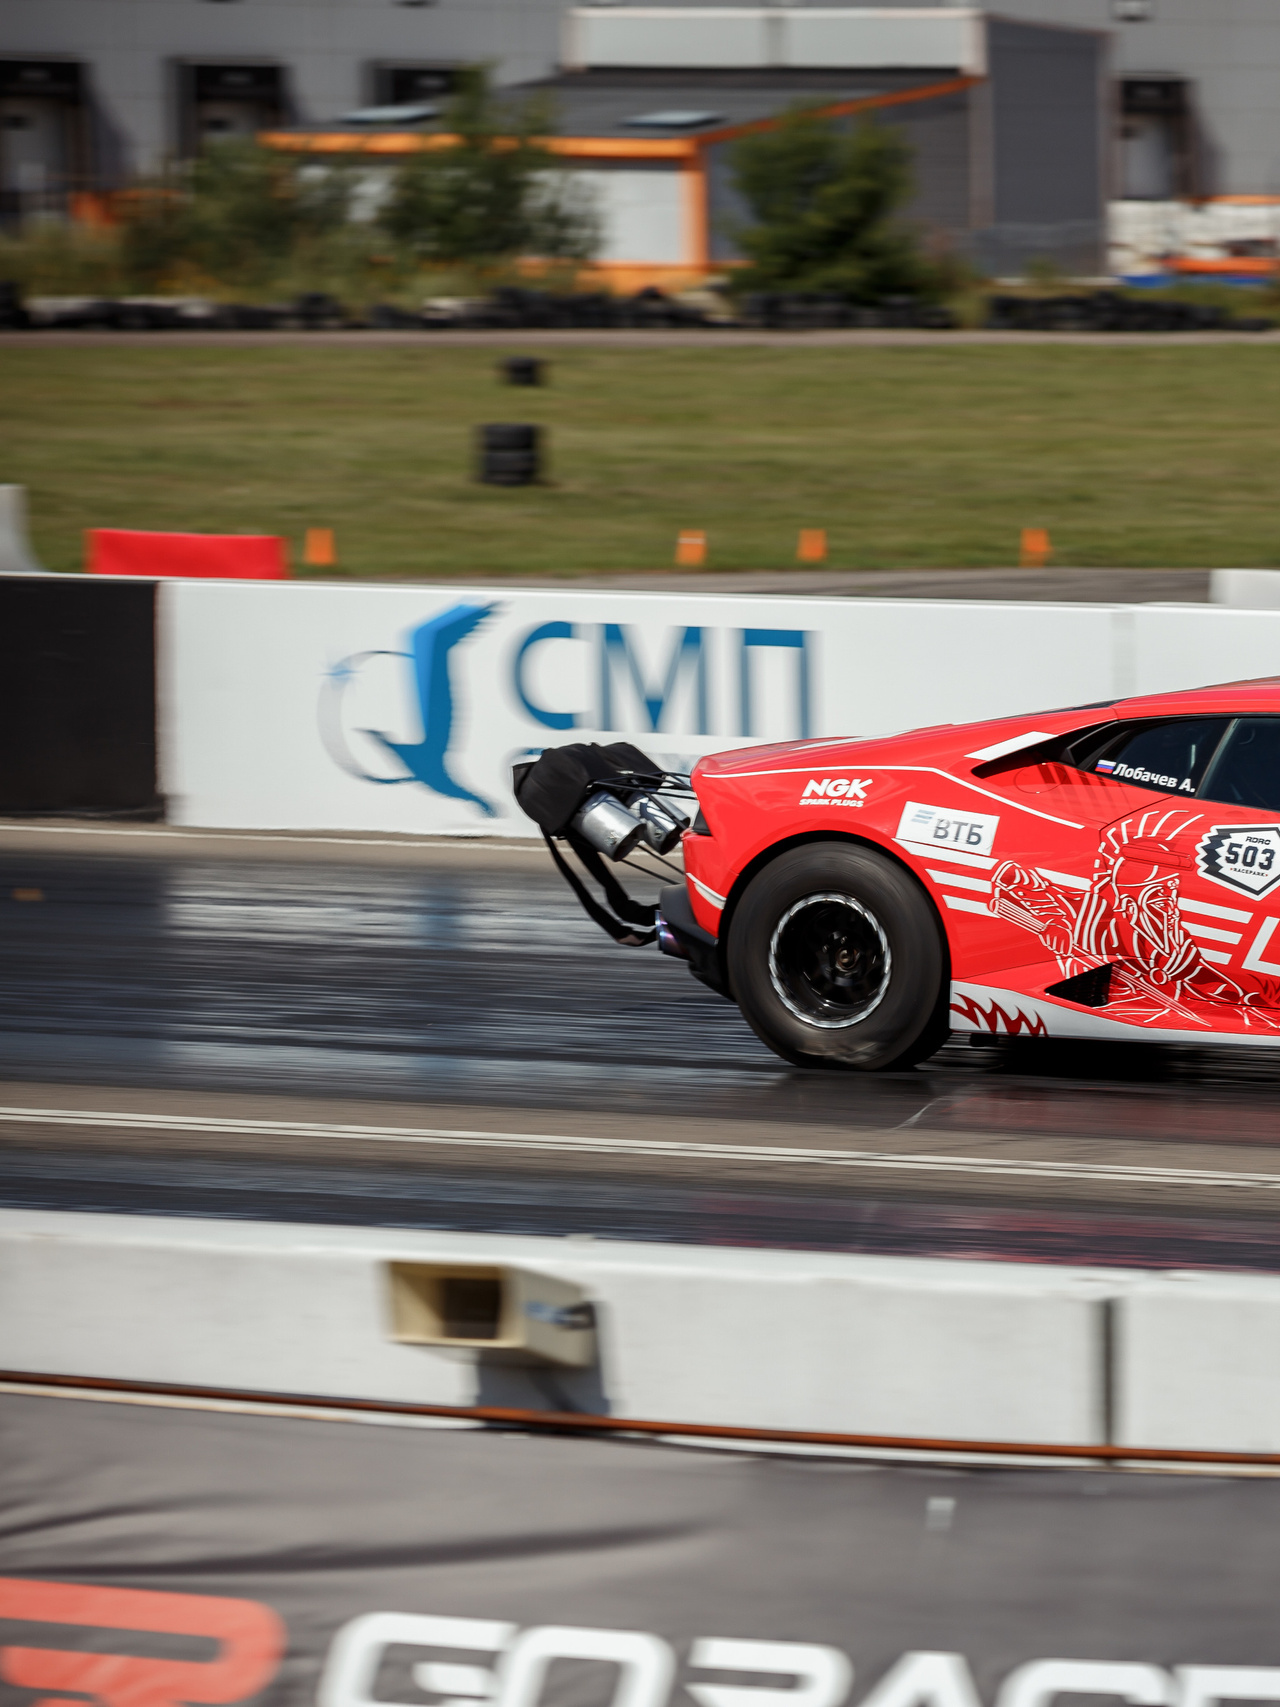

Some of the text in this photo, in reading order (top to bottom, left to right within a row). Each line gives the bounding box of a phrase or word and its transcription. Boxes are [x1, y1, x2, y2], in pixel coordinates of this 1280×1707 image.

[506, 621, 821, 738] СМП
[802, 778, 873, 798] NGK
[1113, 763, 1196, 792] Лобачев А.
[799, 798, 864, 807] SPARK PLUGS
[933, 818, 984, 846] ВТБ
[1225, 843, 1276, 871] 503
